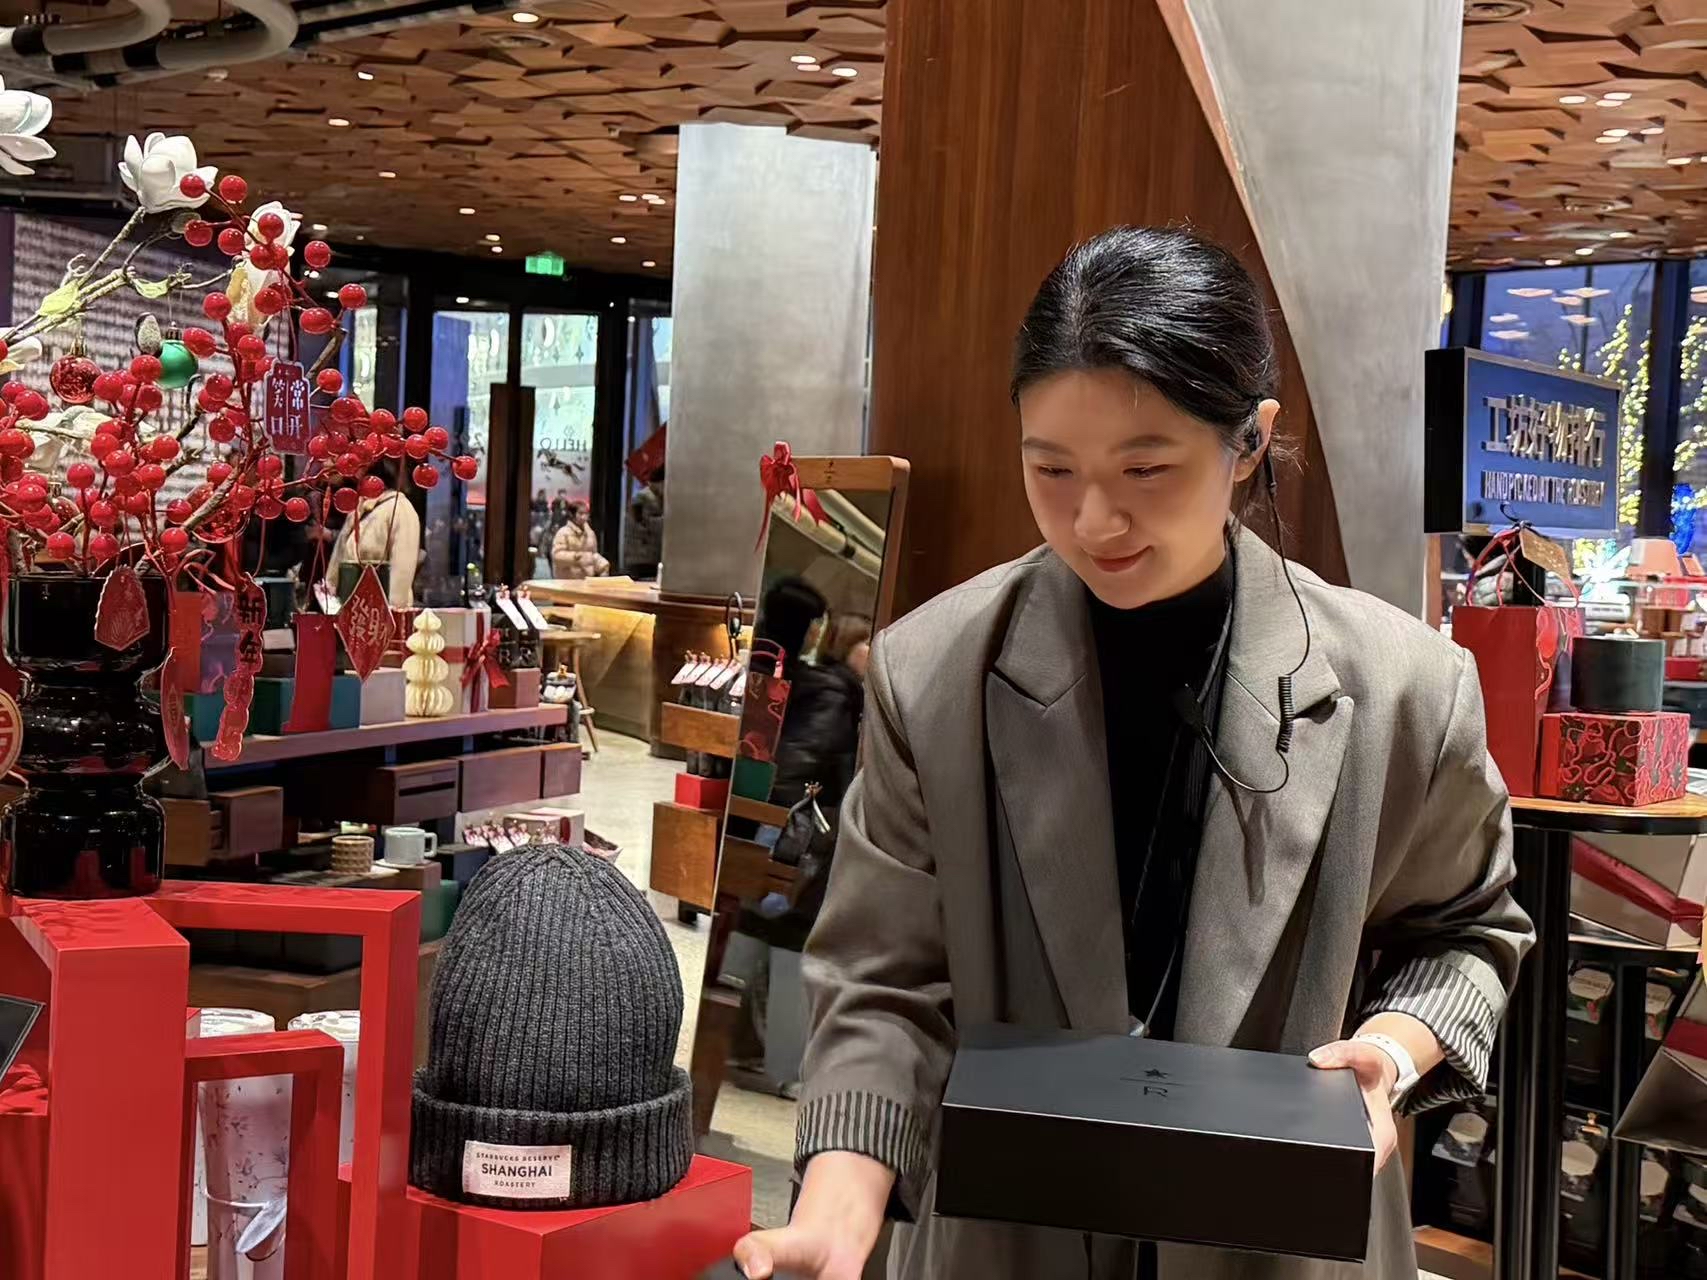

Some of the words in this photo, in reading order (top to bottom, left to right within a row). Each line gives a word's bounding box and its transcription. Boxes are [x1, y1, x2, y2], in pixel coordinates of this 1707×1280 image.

[476, 1152, 520, 1162] STARBUCKS
[481, 1163, 553, 1178] SHANGHAI
[494, 1180, 537, 1189] ROASTERY
